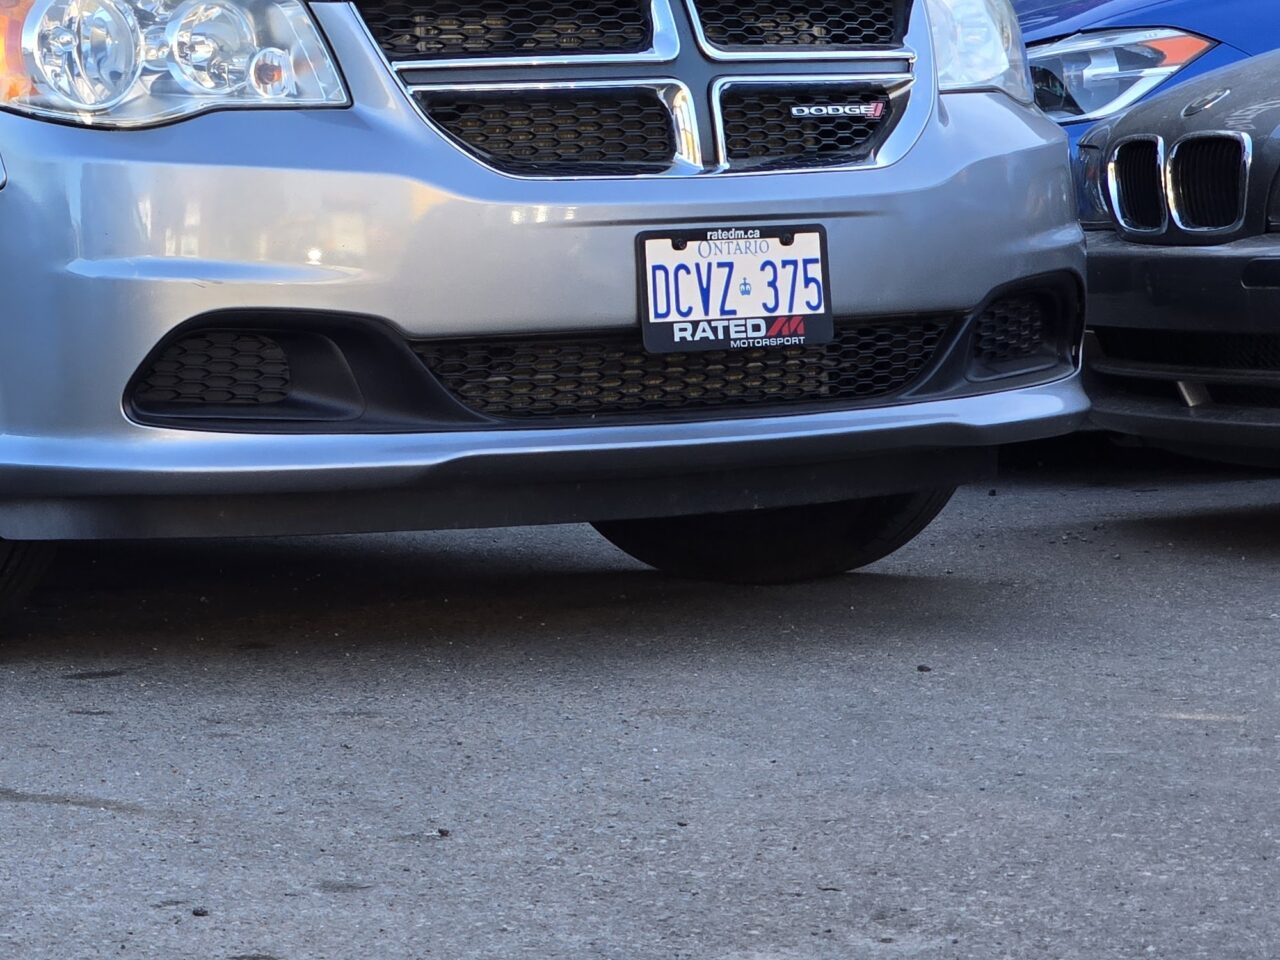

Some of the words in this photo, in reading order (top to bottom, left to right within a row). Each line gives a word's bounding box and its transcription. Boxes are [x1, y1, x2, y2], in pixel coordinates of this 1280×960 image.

[791, 104, 875, 116] DODGE
[707, 228, 760, 240] ratedm.ca
[698, 239, 769, 259] ONTARIO
[651, 261, 737, 319] DCVZ
[760, 258, 823, 314] 375
[673, 318, 767, 342] RATED
[730, 336, 805, 348] MOTORSPORT
